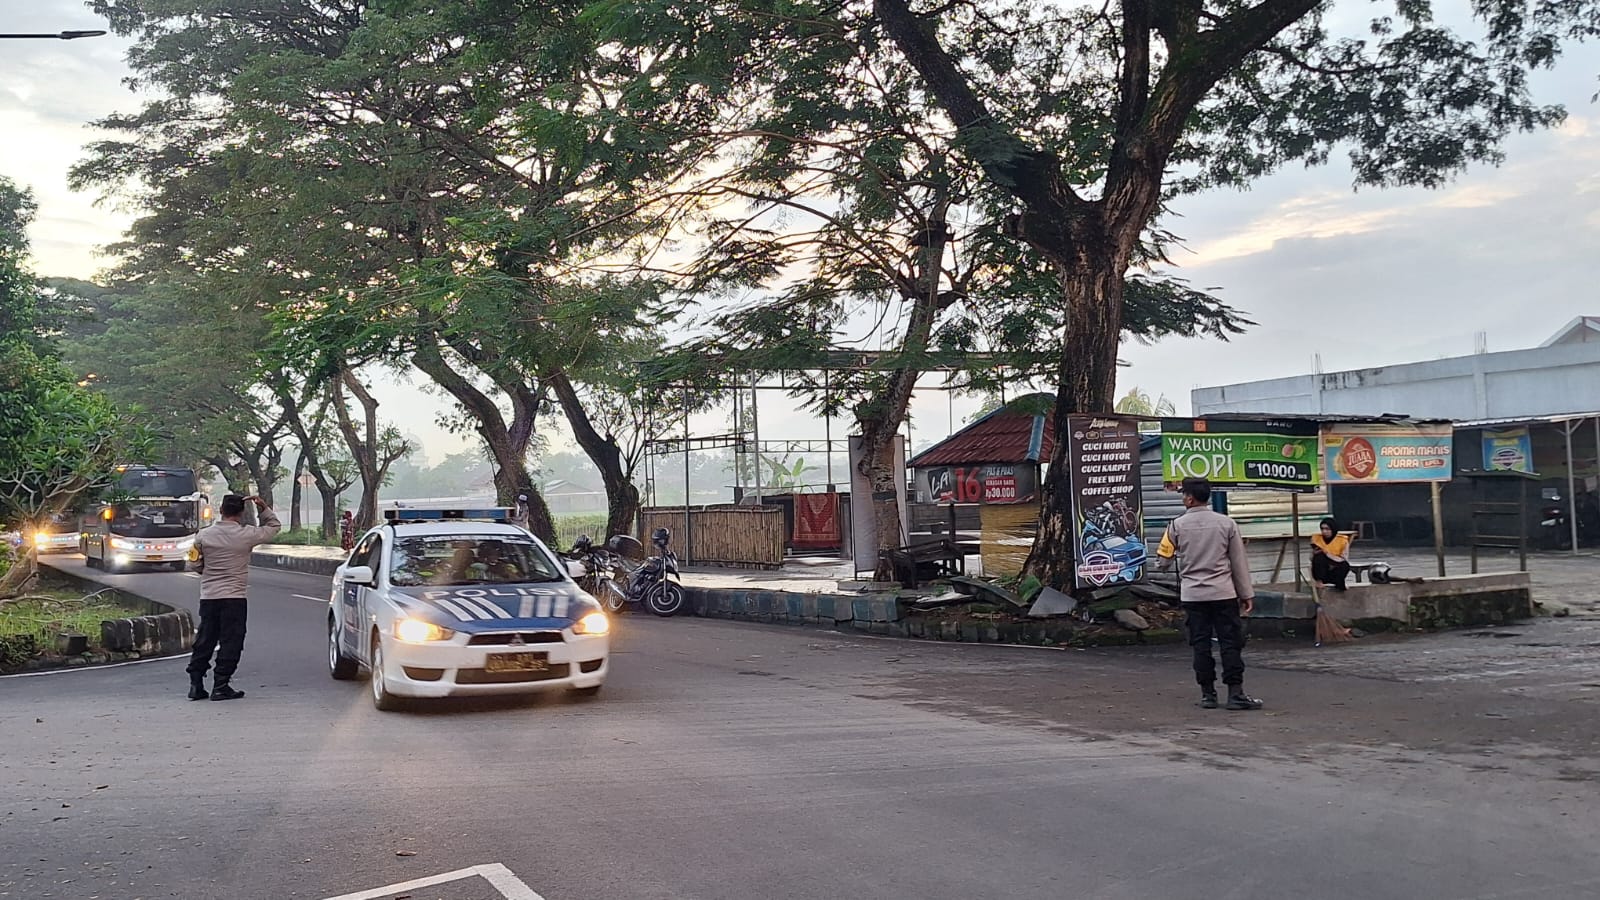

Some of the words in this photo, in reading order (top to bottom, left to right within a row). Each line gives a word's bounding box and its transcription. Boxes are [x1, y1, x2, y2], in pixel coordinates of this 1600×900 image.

[1082, 443, 1101, 451] CUCI
[1103, 441, 1129, 450] MOBIL
[1168, 438, 1232, 451] WARUNG
[1243, 440, 1278, 453] Jambu
[1380, 446, 1416, 456] AROMA
[1417, 446, 1450, 456] MANIS
[1081, 454, 1100, 462] CUCI
[1102, 452, 1131, 461] MOTOR
[1348, 450, 1372, 466] JUARA
[1081, 465, 1100, 473] CUCI
[1102, 463, 1133, 472] KARPET
[1169, 453, 1234, 478] KOPI
[1387, 459, 1419, 468] JUARA
[954, 466, 981, 502] 16
[1088, 476, 1107, 484] FREE
[1108, 474, 1126, 483] WIFI
[1081, 487, 1111, 495] COFFEE
[1112, 485, 1134, 494] SHOP
[423, 588, 569, 600] POLISI
